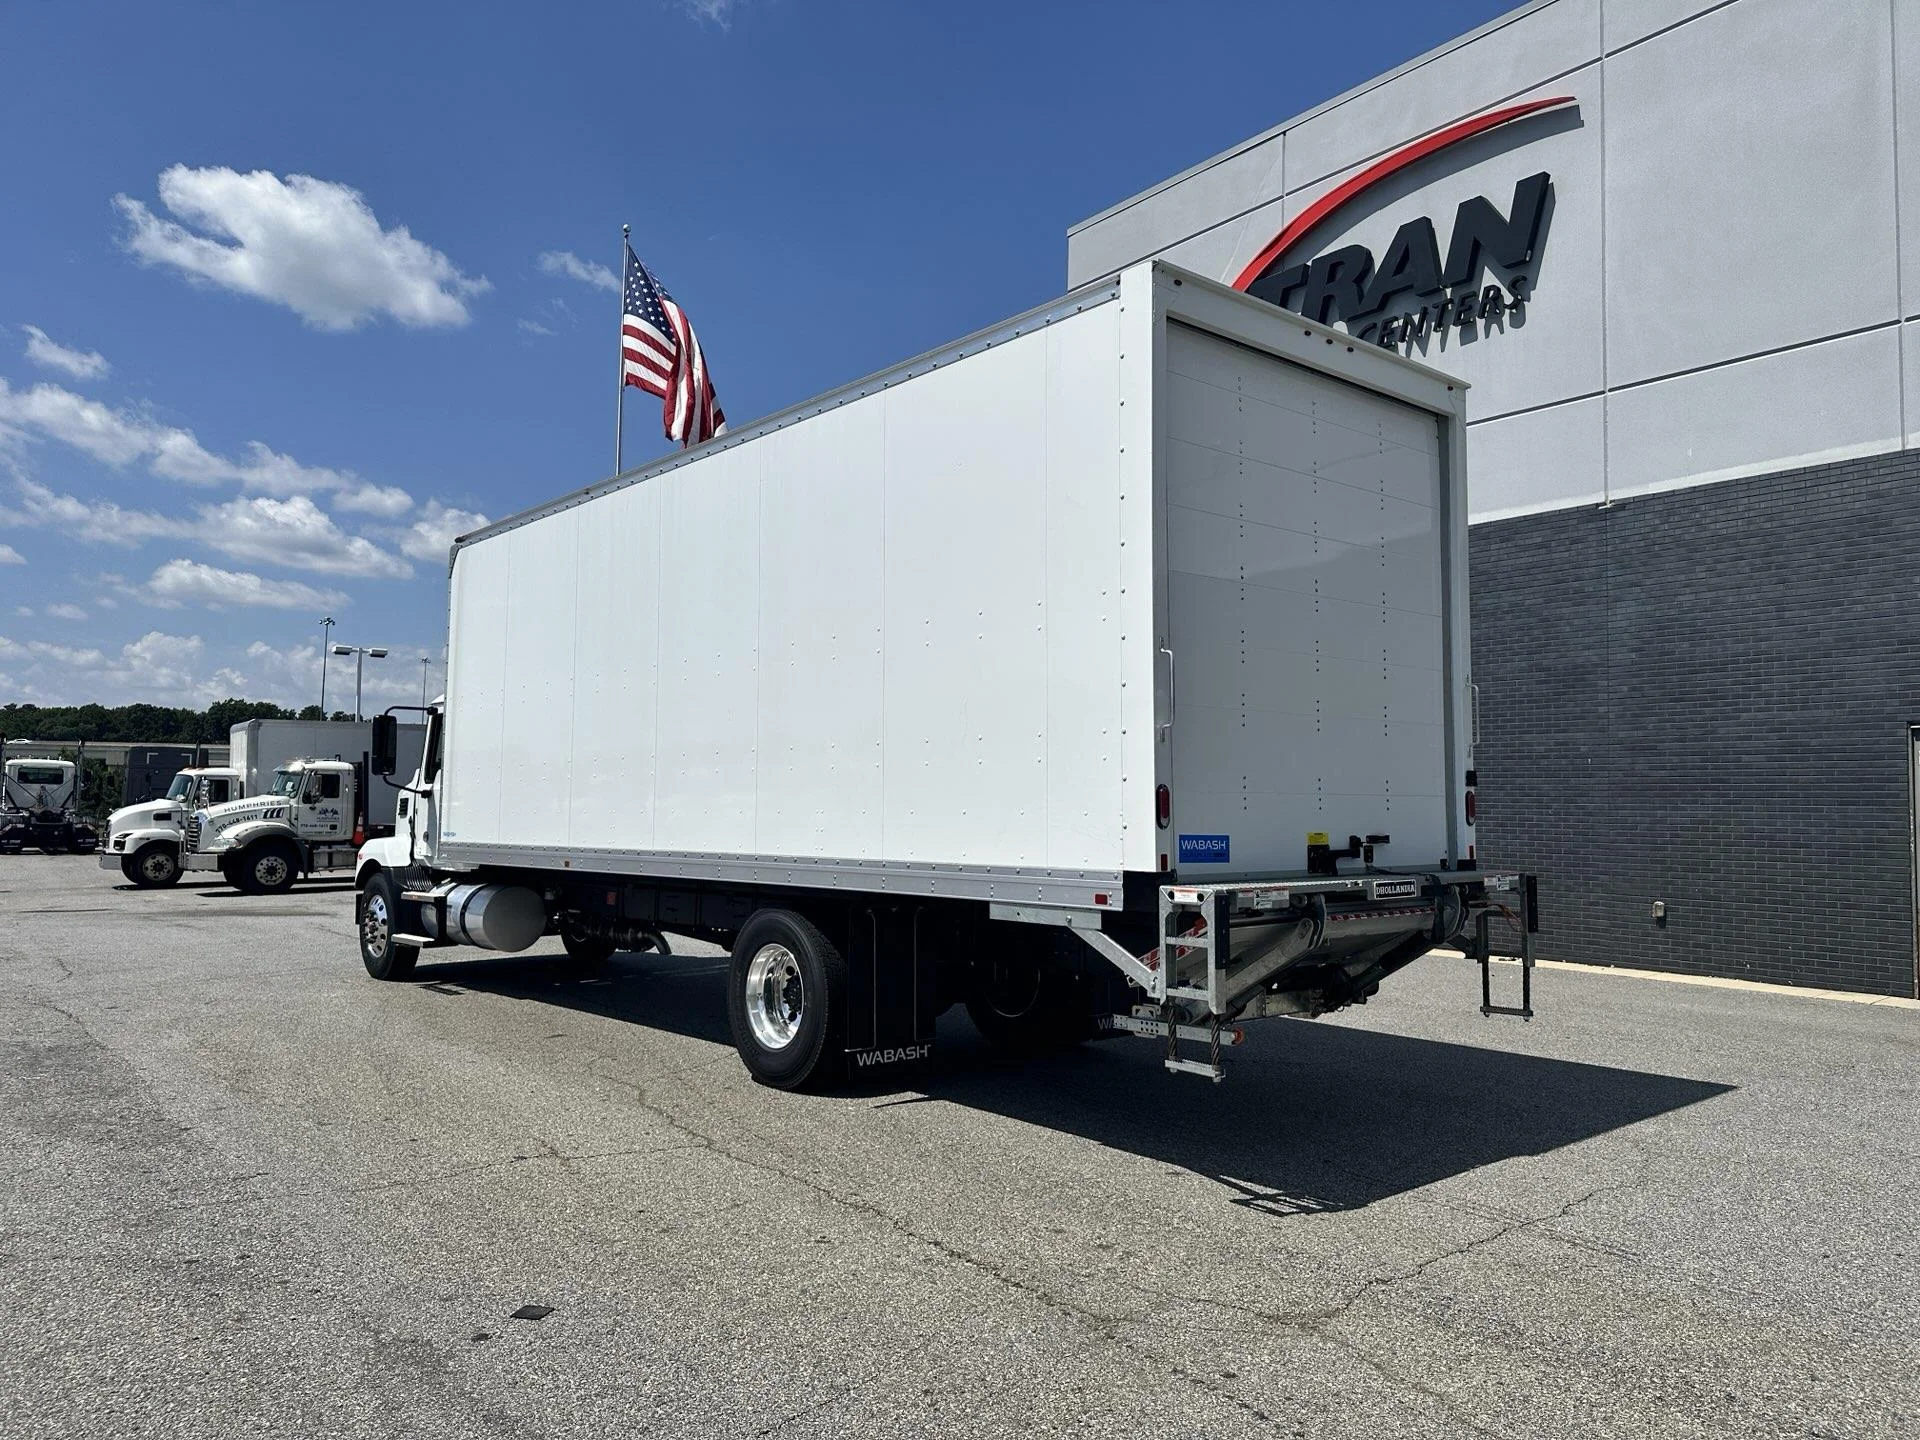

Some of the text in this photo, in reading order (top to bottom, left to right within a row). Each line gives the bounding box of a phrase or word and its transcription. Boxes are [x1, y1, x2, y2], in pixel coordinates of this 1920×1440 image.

[1357, 275, 1528, 349] CENTERS
[223, 800, 282, 814] HUMPHRIES
[1181, 839, 1226, 850] WABASH
[1376, 884, 1415, 895] DHOLLANDIA
[856, 1045, 928, 1067] WABASH
